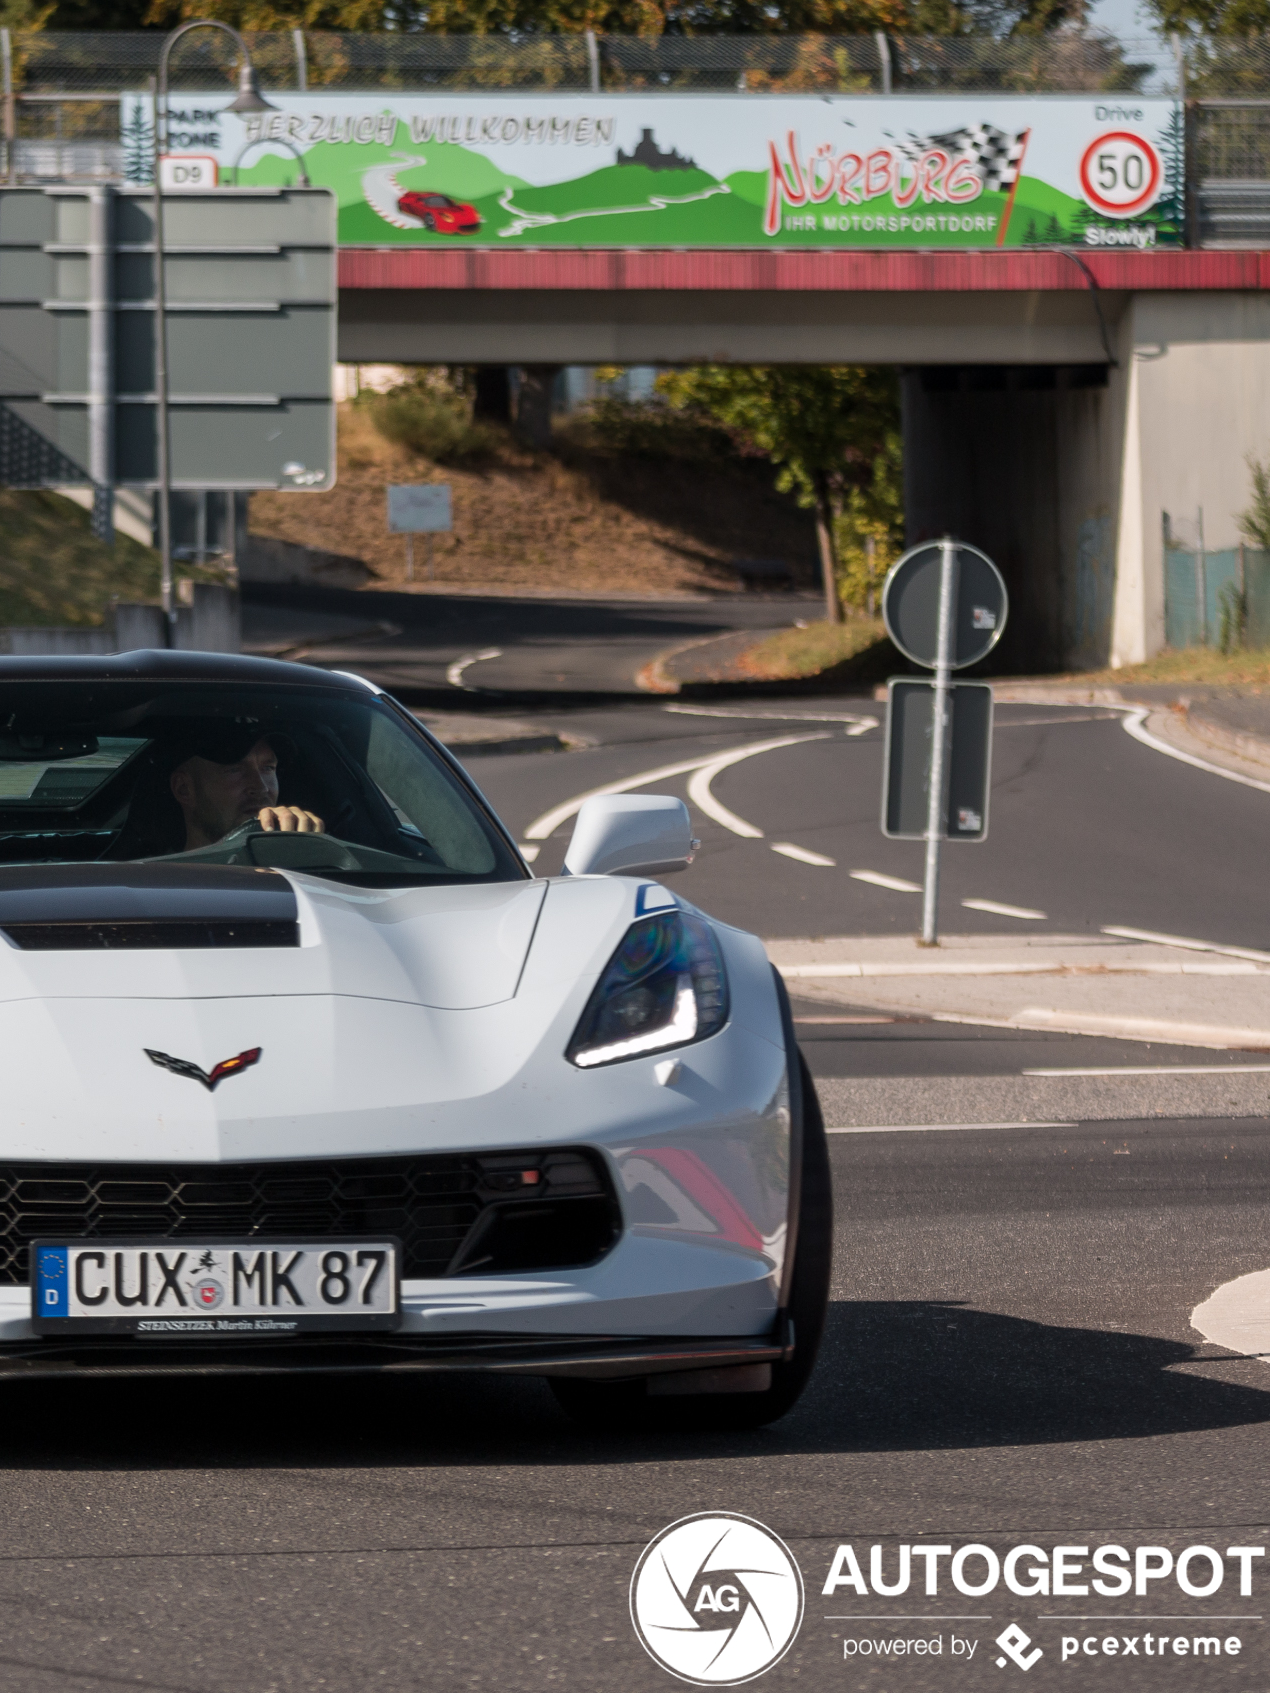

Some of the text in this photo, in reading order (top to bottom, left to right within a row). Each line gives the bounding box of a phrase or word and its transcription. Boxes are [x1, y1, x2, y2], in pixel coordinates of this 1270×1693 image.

[166, 109, 220, 125] PARK
[1094, 105, 1144, 122] Drive
[245, 113, 614, 146] HERZLICH WILLKOMMEN
[173, 165, 202, 184] D9
[763, 129, 983, 236] NÜRBURG
[1098, 154, 1143, 191] 50
[785, 214, 998, 232] IHR MOTORSPORTDORF
[1084, 222, 1157, 248] Slowly!
[74, 1250, 387, 1307] CUX MK 87
[45, 1289, 59, 1305] D
